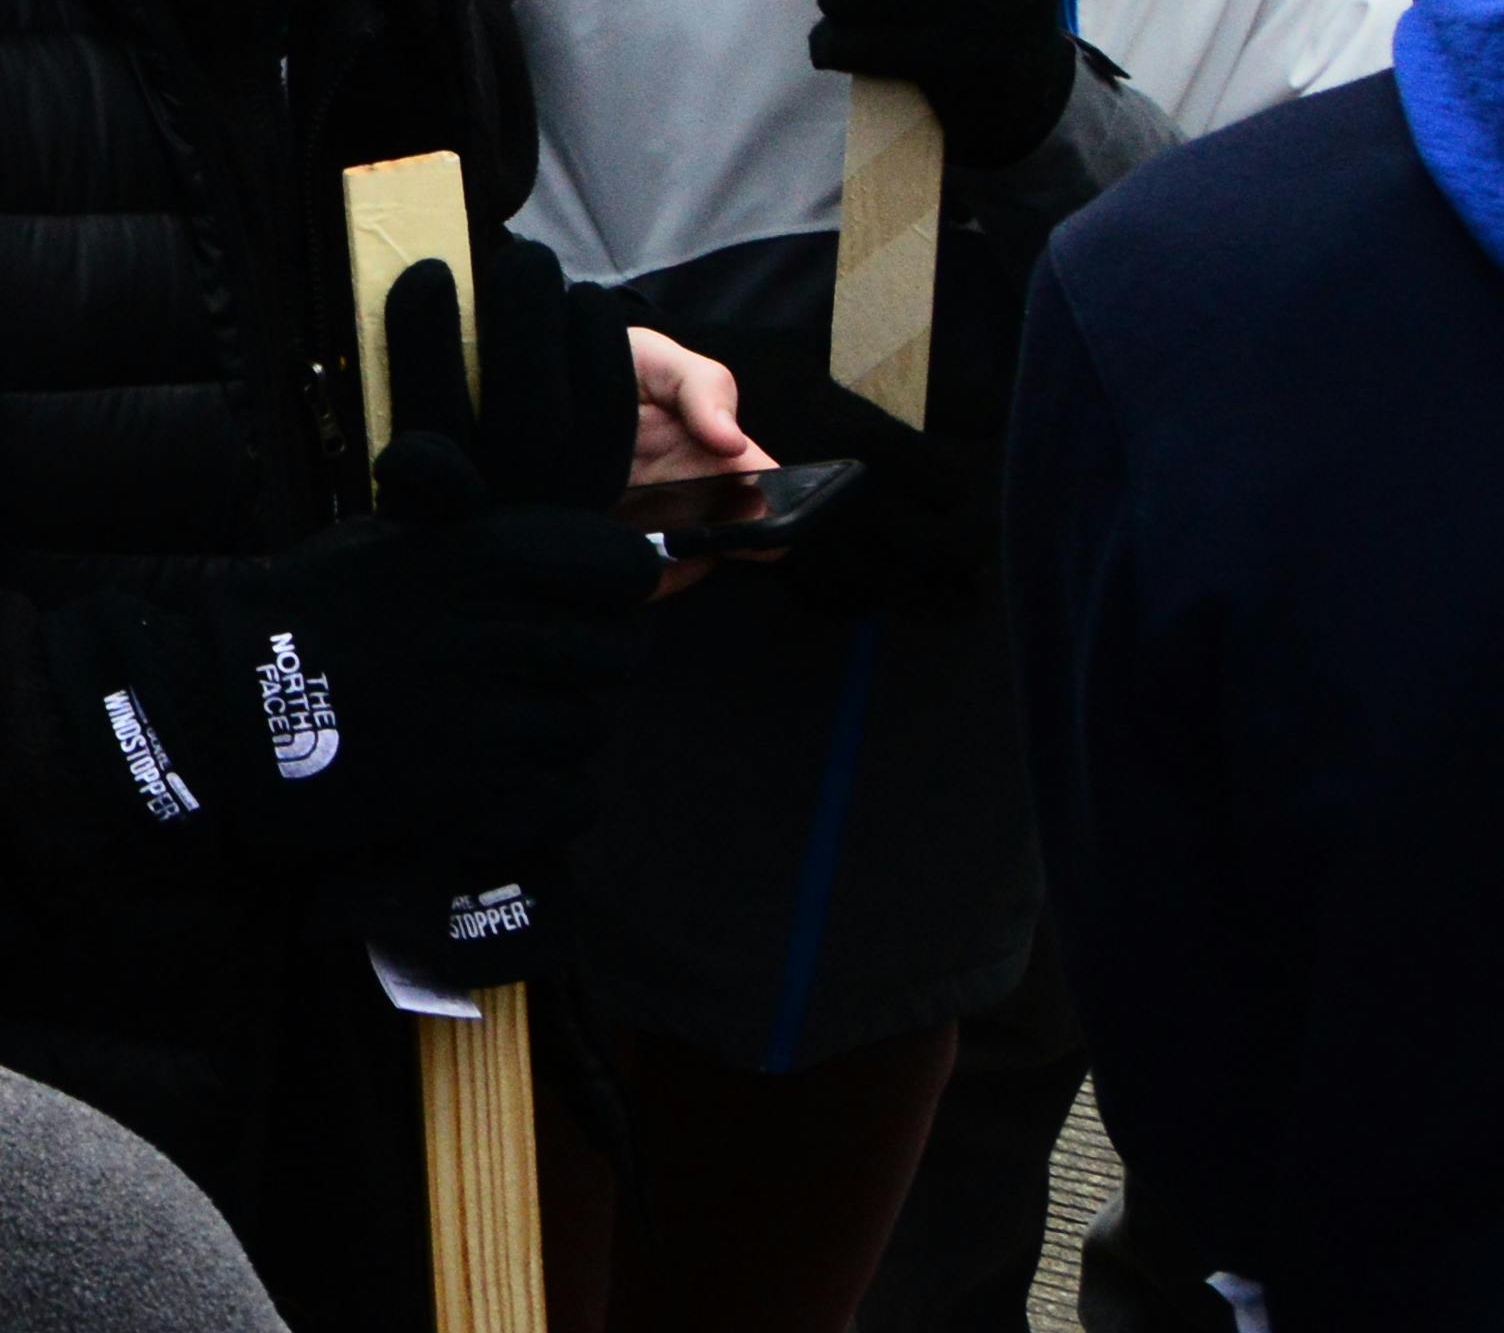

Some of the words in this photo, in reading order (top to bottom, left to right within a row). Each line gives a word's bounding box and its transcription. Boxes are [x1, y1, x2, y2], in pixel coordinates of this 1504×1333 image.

[256, 664, 289, 732] FACE
[270, 633, 312, 731] NORTH
[308, 673, 336, 727] THE
[103, 690, 179, 820] WINDSTOPPER
